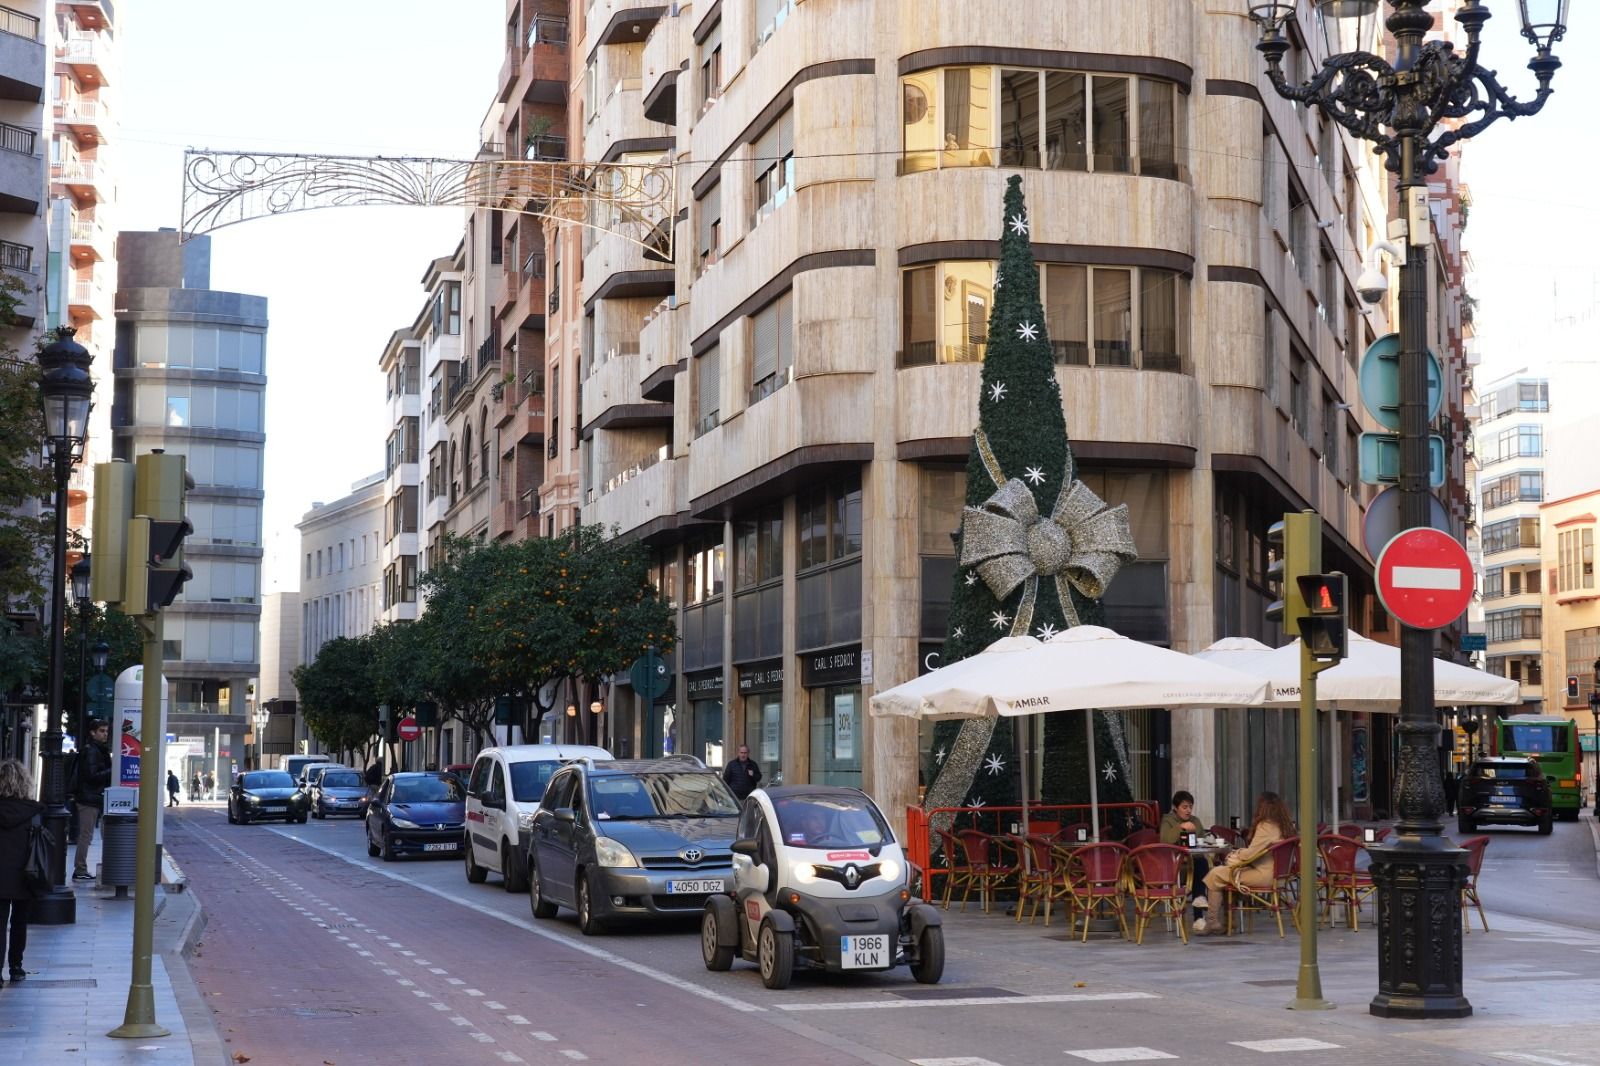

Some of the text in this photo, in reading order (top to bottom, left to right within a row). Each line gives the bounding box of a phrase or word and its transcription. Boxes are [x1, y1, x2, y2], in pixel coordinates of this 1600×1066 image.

[1276, 686, 1301, 697] AMBA
[1015, 696, 1050, 708] AMBAR
[674, 881, 721, 892] 4050 DGZ
[853, 937, 882, 950] 1966
[855, 952, 879, 966] KLN
